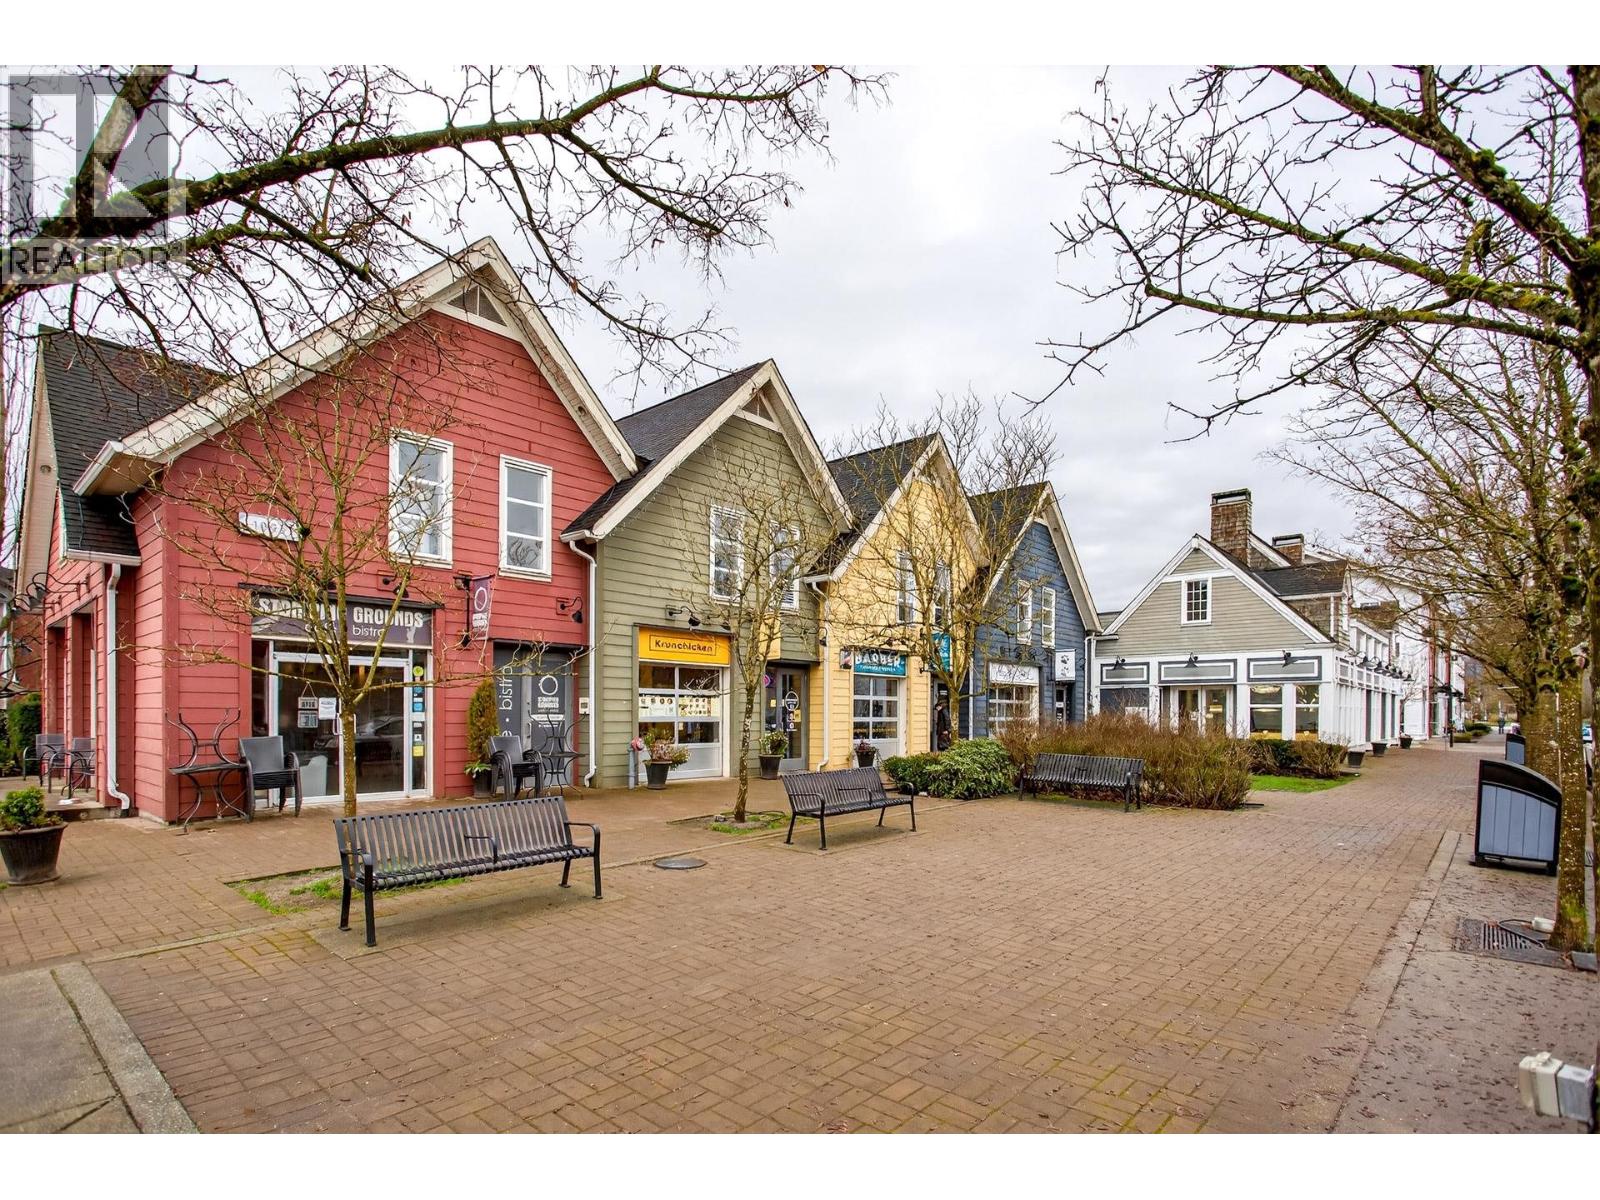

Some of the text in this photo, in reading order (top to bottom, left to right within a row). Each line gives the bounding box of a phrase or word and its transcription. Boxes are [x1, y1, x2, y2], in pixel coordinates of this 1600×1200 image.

[353, 606, 424, 628] GROUNDS
[655, 640, 713, 653] Krunchicken
[498, 666, 513, 710] bistro
